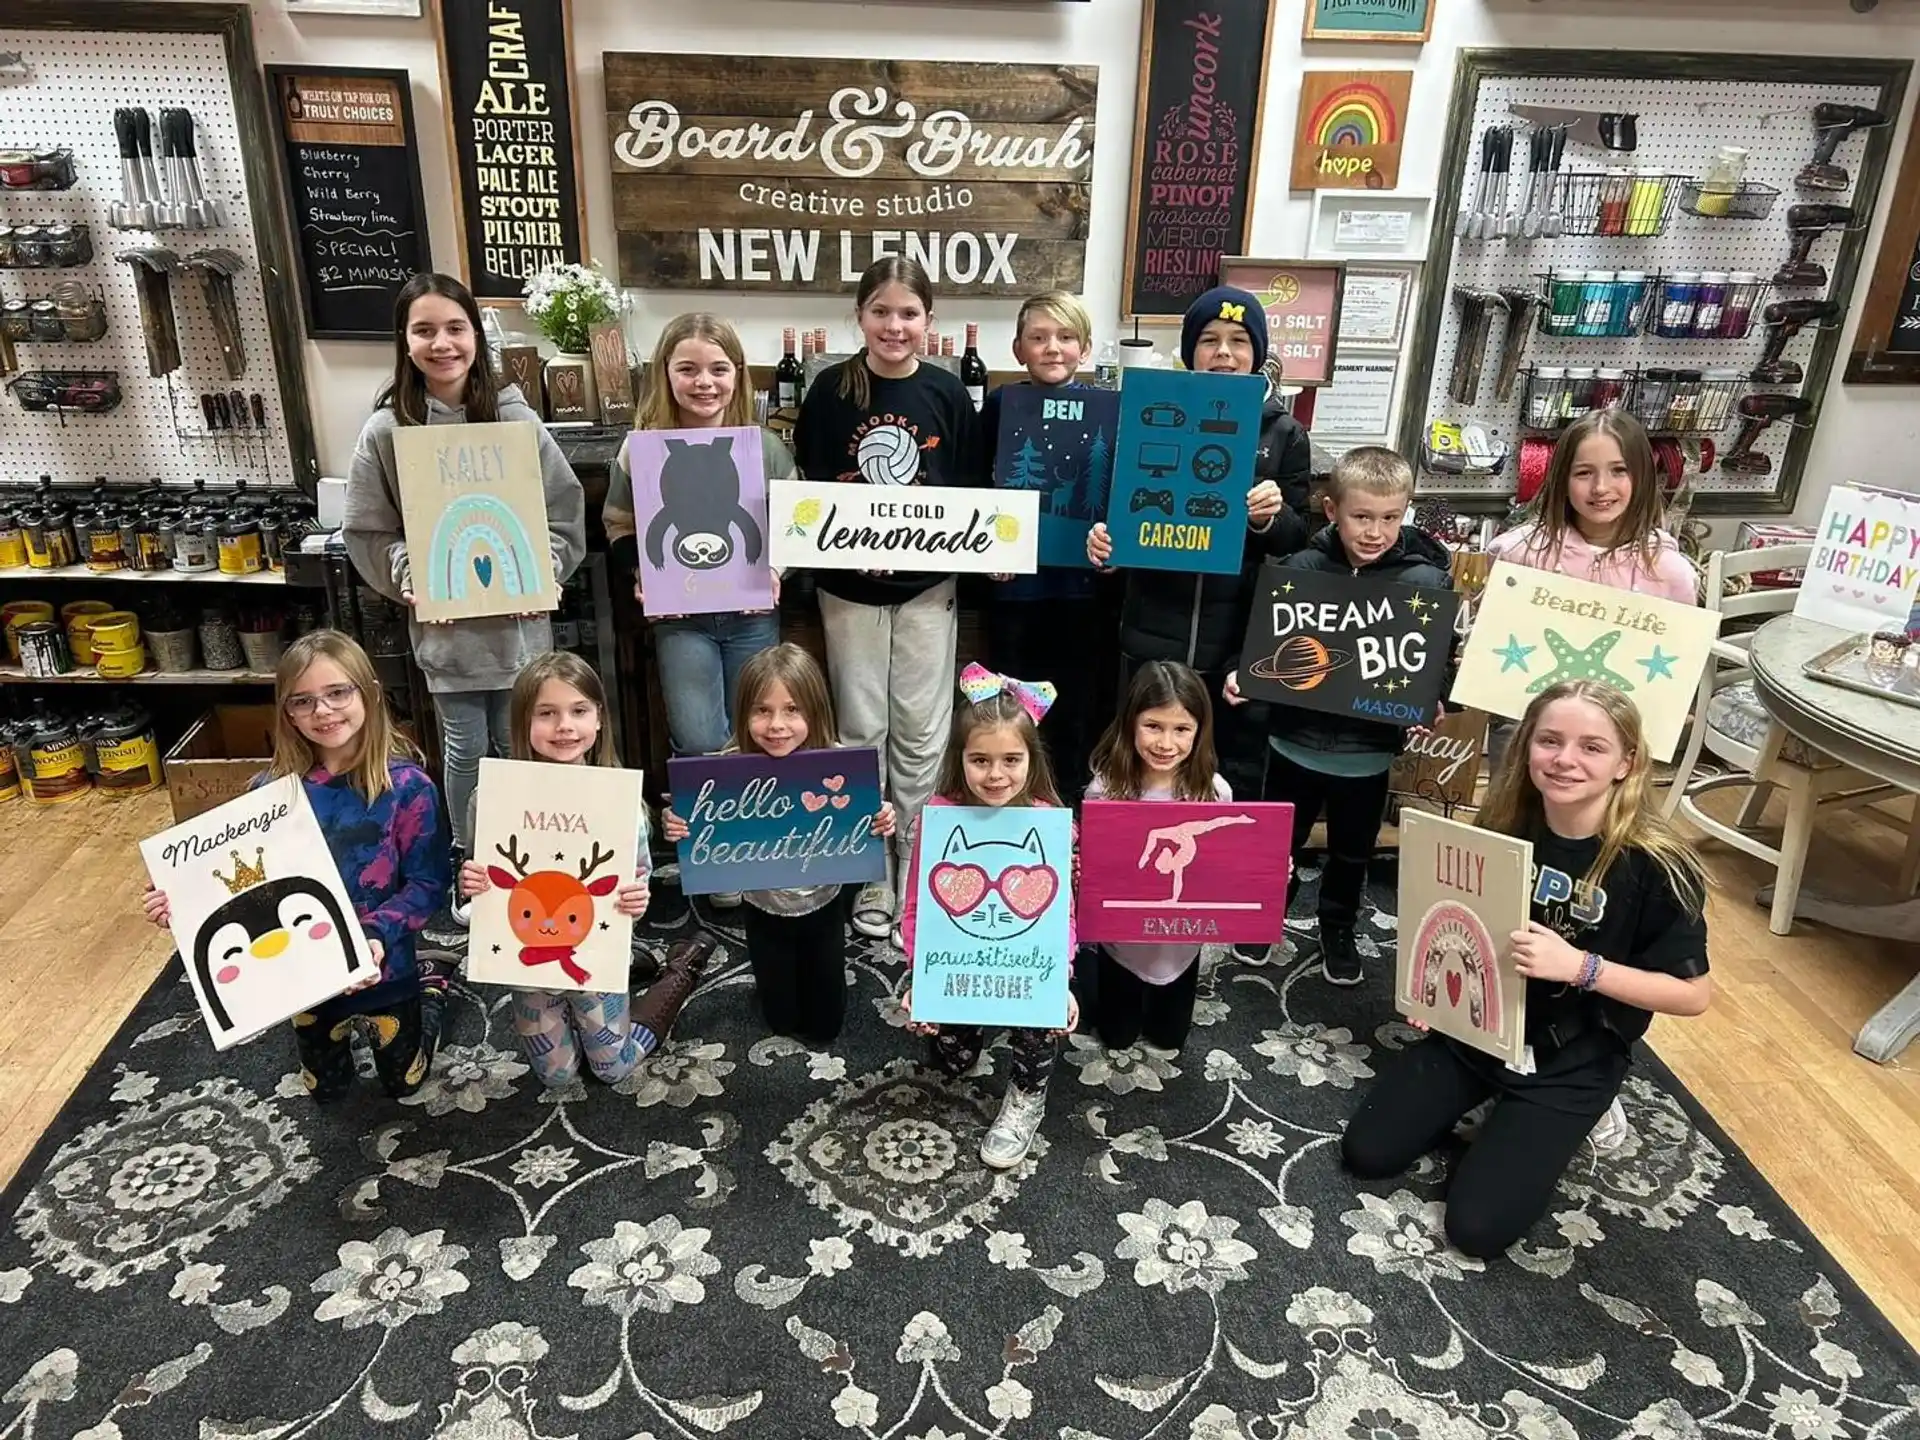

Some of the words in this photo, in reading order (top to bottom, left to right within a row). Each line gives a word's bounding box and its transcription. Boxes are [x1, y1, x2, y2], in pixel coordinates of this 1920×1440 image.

[488, 0, 529, 80] CRAF
[1184, 11, 1222, 141] uncork
[474, 80, 550, 115] ALE
[303, 104, 340, 118] TRULY
[343, 106, 394, 121] CHOICES
[472, 118, 555, 143] PORTER
[614, 100, 816, 168] Board
[820, 86, 916, 177] &
[906, 110, 1090, 177] Brush
[300, 148, 360, 168] Blueberry
[475, 143, 557, 166] LAGER
[303, 165, 350, 183] Cherry
[477, 167, 522, 192] PALE
[527, 168, 559, 194] ALE
[1151, 164, 1238, 183] cabernet
[307, 185, 338, 201] Wild
[345, 187, 380, 205] Berry
[480, 195, 560, 218] STOUT
[739, 182, 864, 217] creative
[876, 184, 973, 217] studio
[1149, 184, 1234, 207] PINOT
[309, 207, 367, 227] Strawberry
[371, 209, 397, 224] lime
[1147, 207, 1231, 227] moscato
[1146, 226, 1231, 249] MERLOT
[315, 240, 399, 264] SPECIAL!
[698, 227, 821, 282] NEW
[840, 229, 1019, 284] LENOX
[348, 266, 416, 282] MIMOSAS
[1219, 301, 1246, 322] M
[1286, 314, 1327, 330] SALT
[1282, 342, 1324, 360] SALT
[604, 395, 629, 410] love
[1042, 398, 1085, 421] BEN
[848, 413, 919, 456] MINOOKA
[437, 442, 506, 487] KALEY
[869, 502, 898, 518] ICE
[902, 504, 945, 520] COLD
[816, 503, 994, 554] lemonade
[1138, 521, 1213, 551] CARSON
[1826, 511, 1920, 560] HAPPY
[1814, 547, 1919, 591] BIRTHDAY
[1271, 596, 1396, 637] DREAM
[1530, 585, 1608, 621] Beach
[1612, 605, 1669, 636] Life
[1356, 631, 1428, 681] BIG
[1352, 695, 1425, 724] MASON
[689, 776, 795, 824] hello
[162, 802, 289, 868] Mackenzie
[523, 809, 589, 835] MAYA
[690, 814, 873, 873] beautiful
[1436, 841, 1486, 898] LILLY
[1142, 917, 1220, 937] EMMA
[943, 972, 1034, 1001] AWESOME
